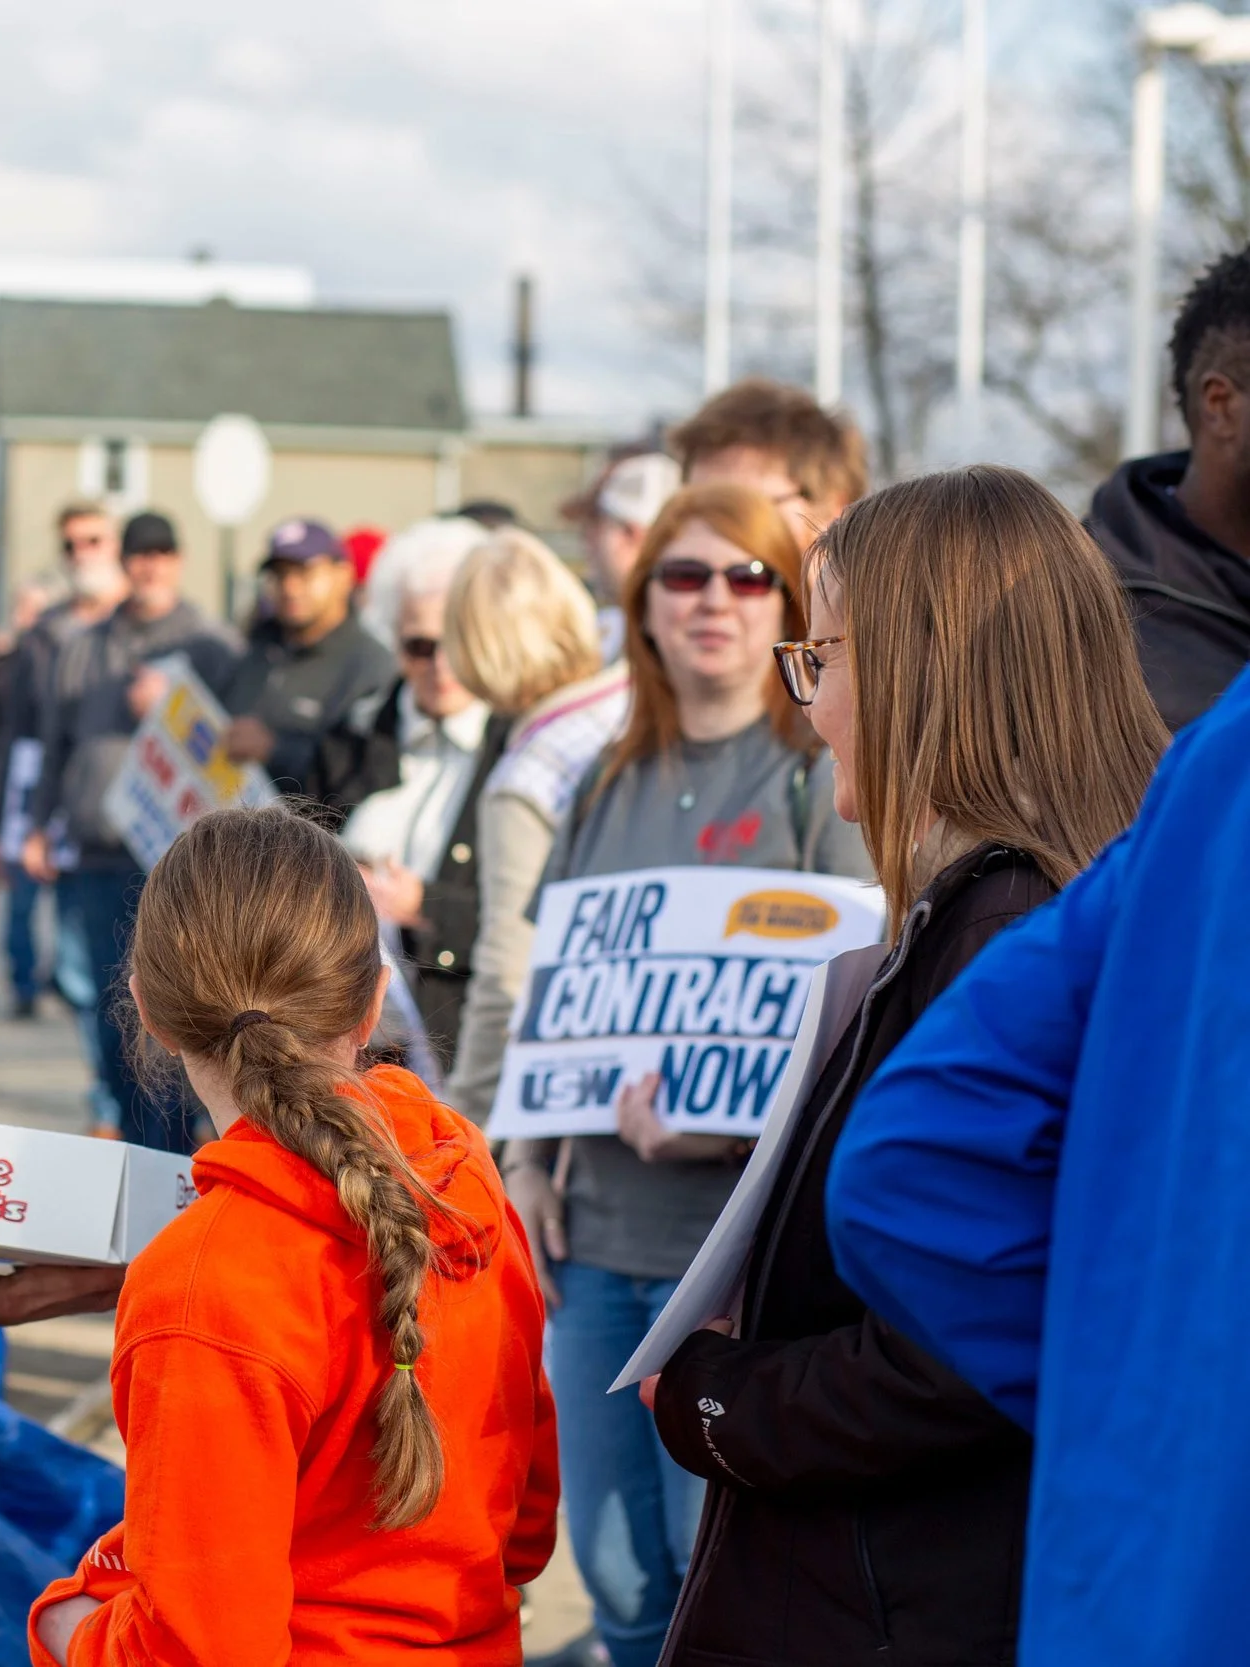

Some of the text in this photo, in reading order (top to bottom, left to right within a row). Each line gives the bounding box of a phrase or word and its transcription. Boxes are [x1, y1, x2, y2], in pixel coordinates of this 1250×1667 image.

[559, 880, 668, 957] FAIR
[536, 957, 814, 1041] CONTRACT
[520, 1066, 622, 1112] USW
[652, 1043, 792, 1119] NOW
